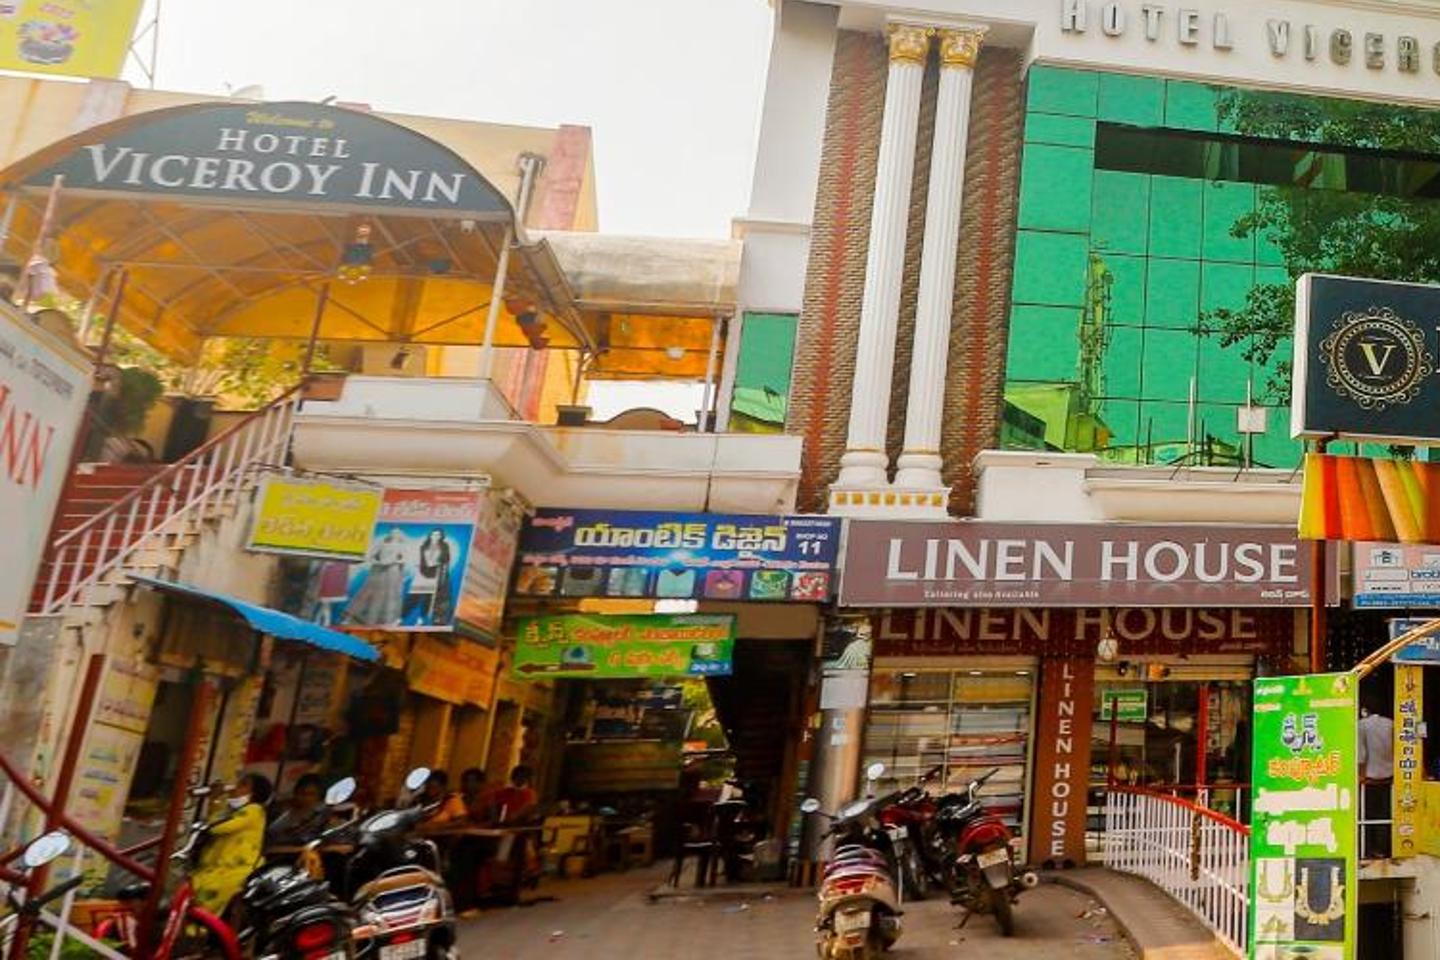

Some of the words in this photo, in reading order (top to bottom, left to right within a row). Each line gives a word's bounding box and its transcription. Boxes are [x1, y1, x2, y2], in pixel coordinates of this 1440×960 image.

[217, 127, 351, 159] HOTEL
[83, 143, 339, 196] VICEROY
[353, 162, 467, 204] INN
[1358, 339, 1396, 376] V
[799, 541, 821, 555] 11
[886, 539, 1074, 581] LINEN
[1100, 541, 1297, 583] HOUSE
[879, 608, 1050, 640] LINEN
[1075, 608, 1257, 641] HOUSE
[1056, 663, 1074, 754] LINEN
[1051, 764, 1071, 856] HOUSE
